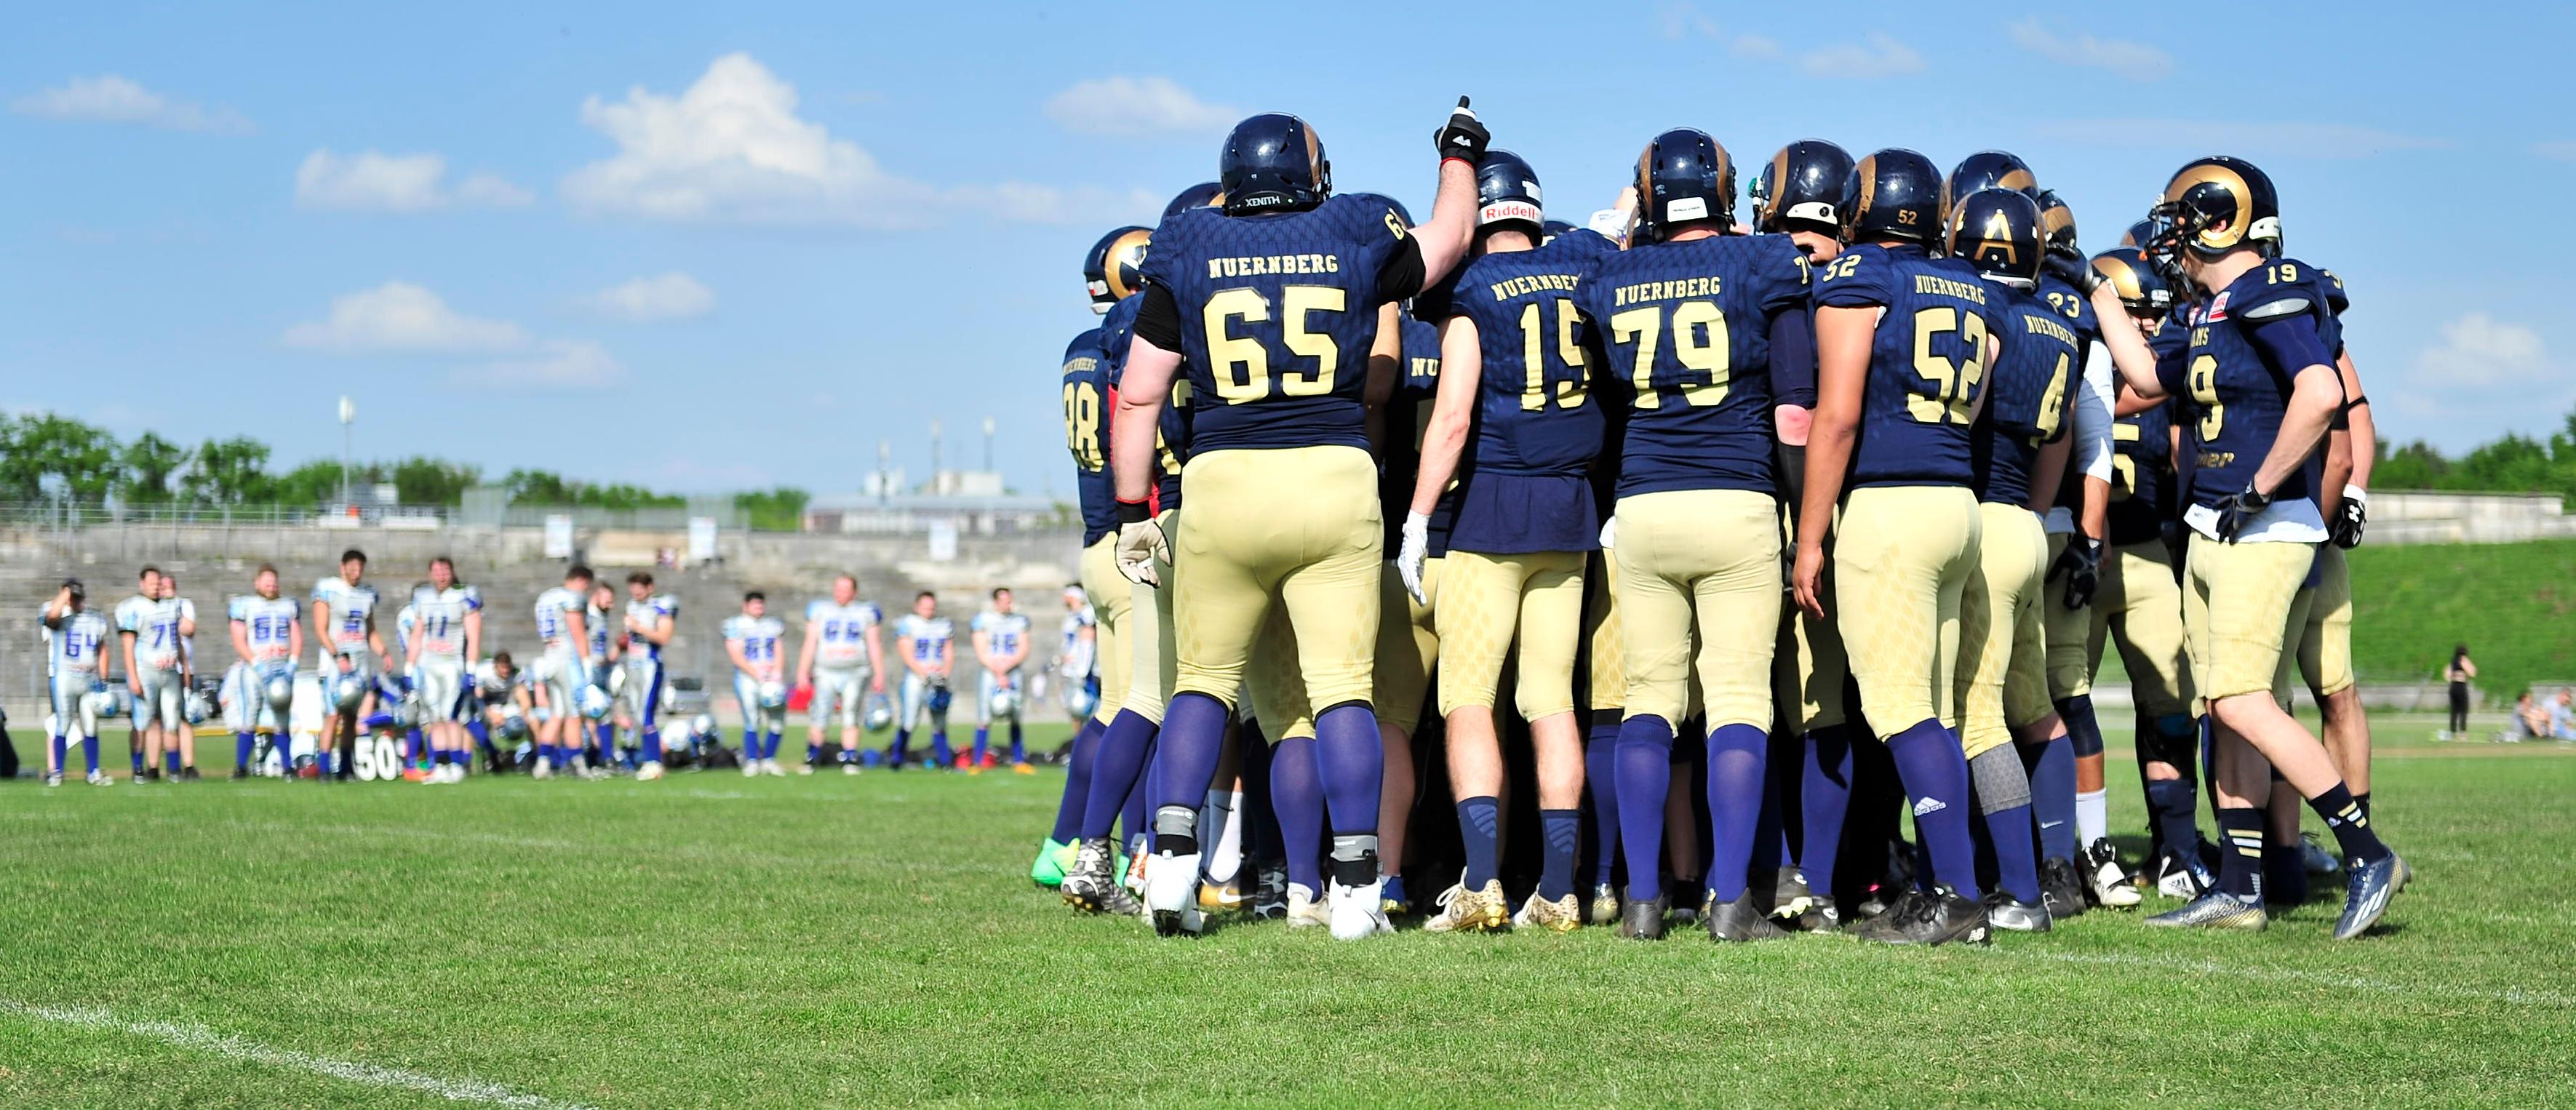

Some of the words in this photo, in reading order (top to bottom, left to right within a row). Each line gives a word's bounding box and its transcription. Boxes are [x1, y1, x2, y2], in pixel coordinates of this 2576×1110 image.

[1245, 196, 1280, 207] XENITH
[1486, 206, 1536, 219] Riddell
[1898, 210, 1918, 225] 52
[1974, 209, 2017, 265] A
[1208, 255, 1339, 279] NUERNBERG
[1822, 254, 1862, 282] 52
[2268, 263, 2297, 284] 19
[1616, 276, 1720, 306] NUERNBERG
[1915, 274, 1986, 306] NUERNBERG
[1203, 286, 1345, 405] 65
[1520, 299, 1590, 412] 15
[1611, 300, 1730, 409] 79
[1907, 307, 1987, 425] 52
[354, 736, 397, 781] 50
[1966, 927, 1986, 943] NB
